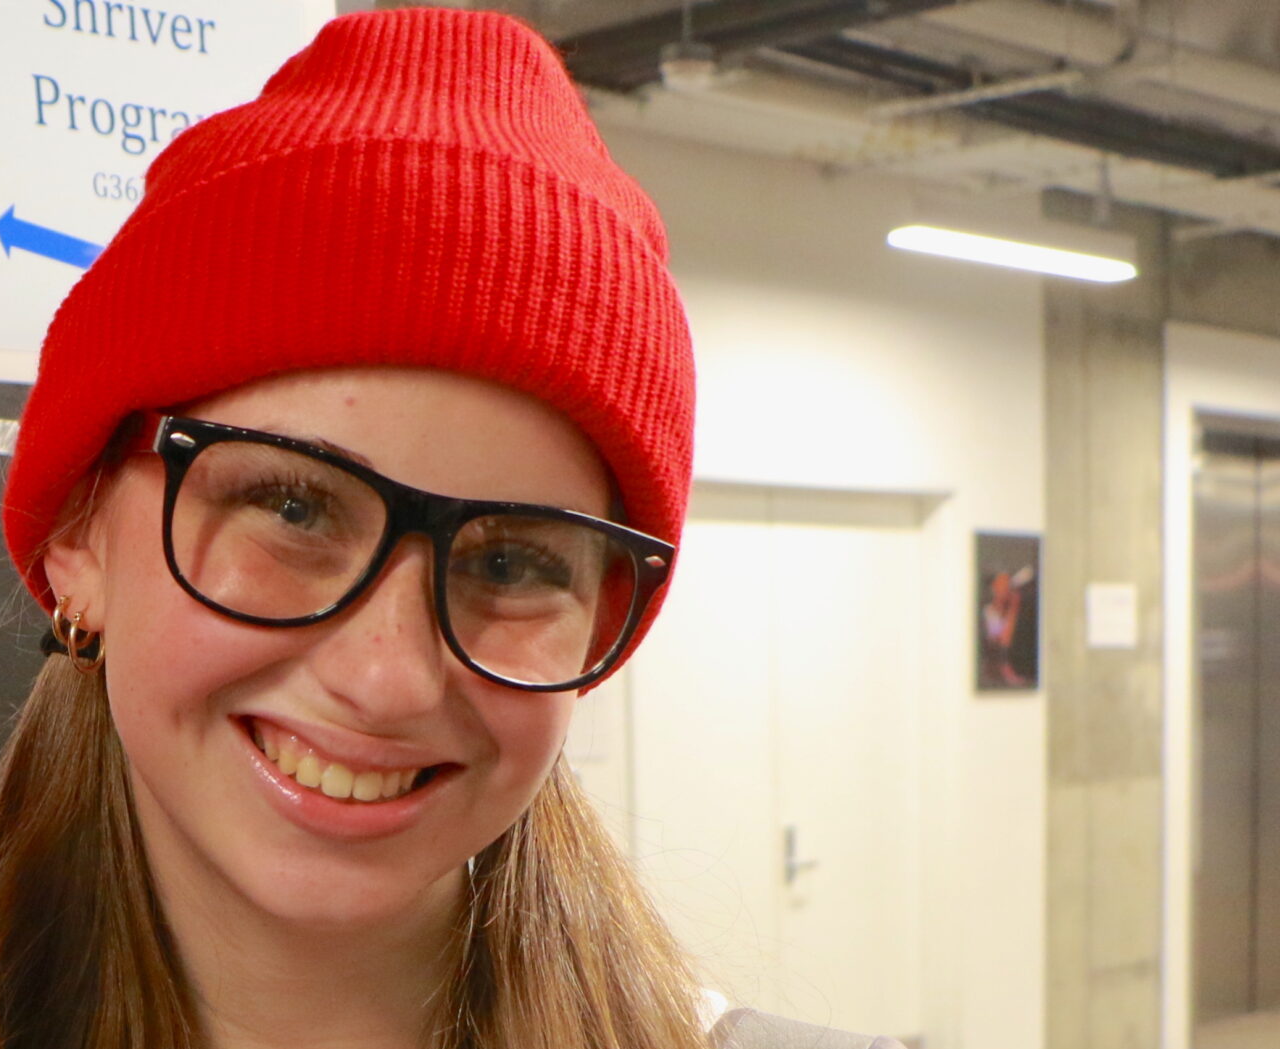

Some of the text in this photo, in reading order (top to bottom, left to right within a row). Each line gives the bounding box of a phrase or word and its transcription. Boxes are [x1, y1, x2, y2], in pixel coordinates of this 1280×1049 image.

[43, 0, 216, 54] Shriver
[32, 73, 204, 155] Progra
[93, 171, 145, 202] G36
